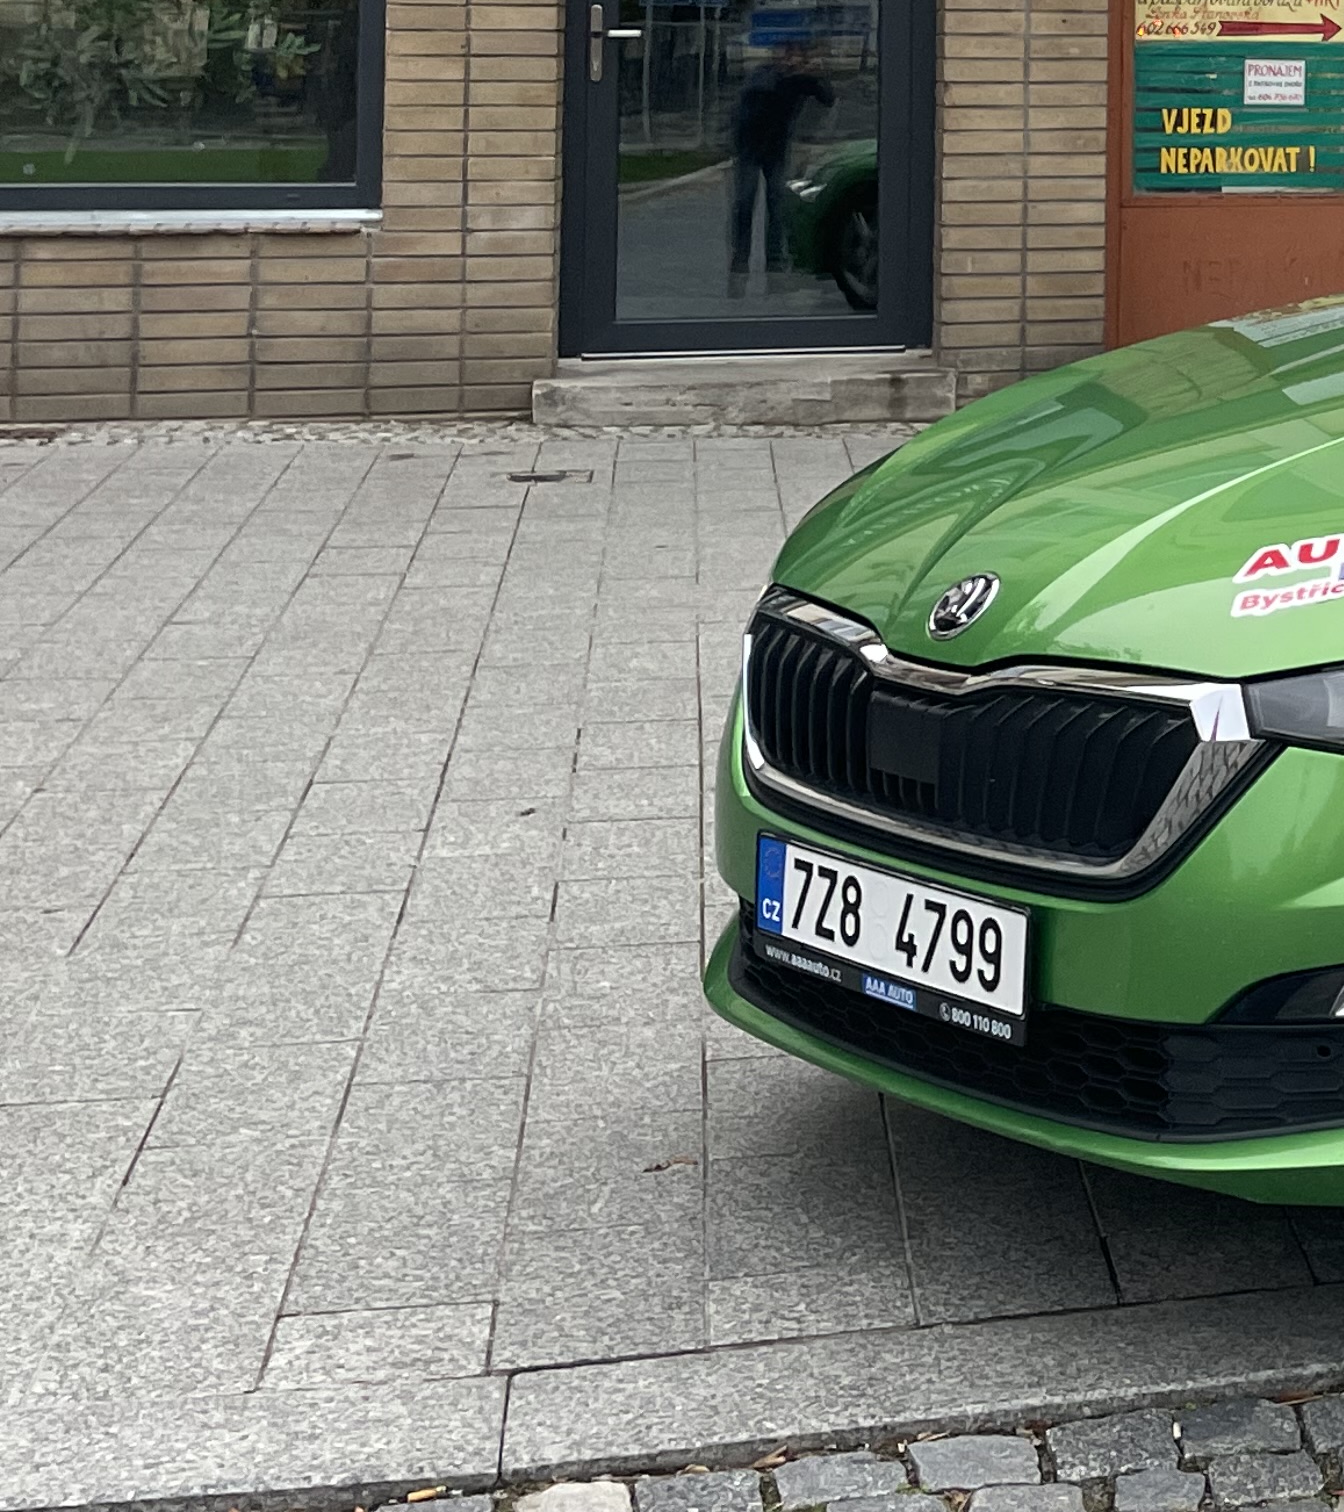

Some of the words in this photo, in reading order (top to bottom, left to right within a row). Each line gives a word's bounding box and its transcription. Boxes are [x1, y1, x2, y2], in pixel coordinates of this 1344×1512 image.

[1161, 108, 1232, 134] VJEZD
[1160, 146, 1299, 173] NEPARKOVAT
[762, 898, 781, 923] CZ
[791, 857, 862, 948] 7Z8
[895, 893, 1003, 993] 4799
[865, 976, 886, 996] AAA
[888, 983, 914, 1004] AUTO
[952, 1006, 971, 1027] 800
[972, 1013, 990, 1033] 110
